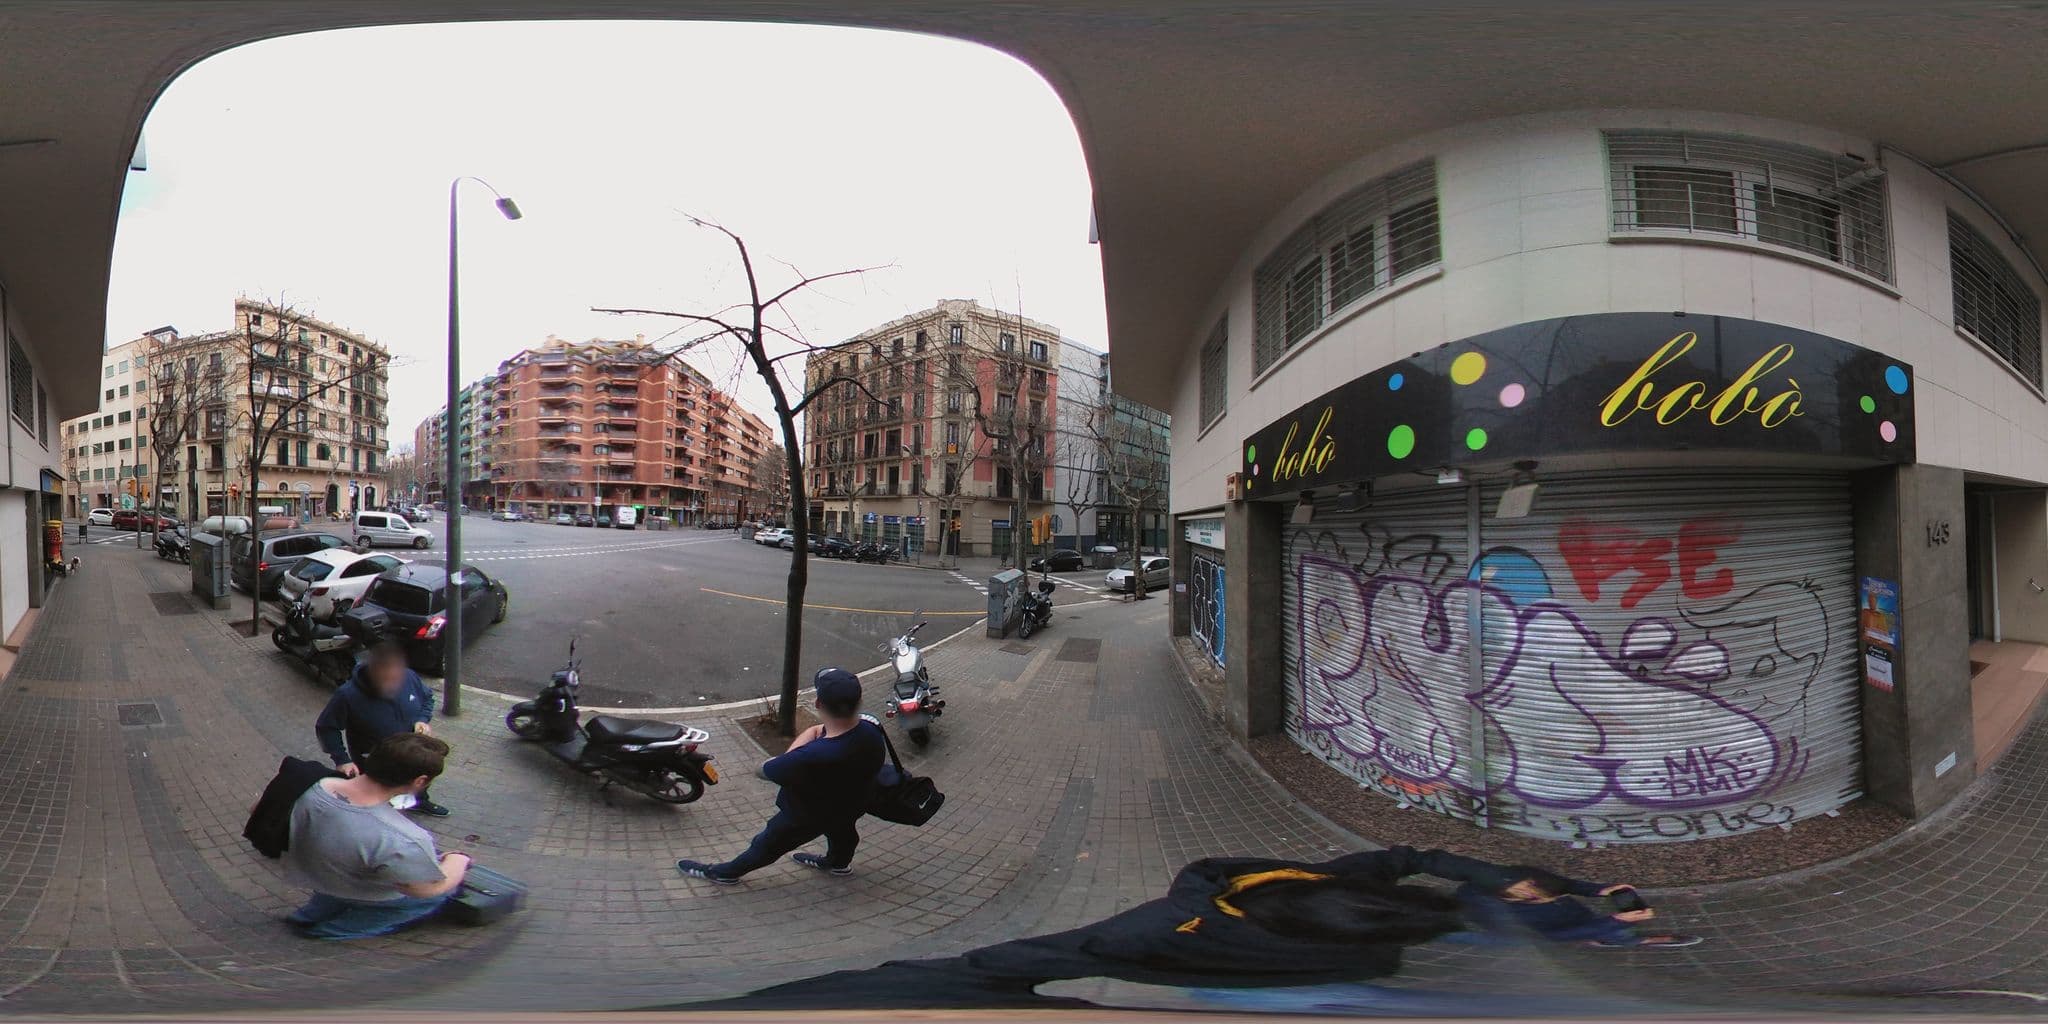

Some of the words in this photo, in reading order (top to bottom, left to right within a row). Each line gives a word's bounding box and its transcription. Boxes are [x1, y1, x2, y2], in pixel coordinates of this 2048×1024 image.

[1598, 331, 1805, 428] bobò
[1272, 406, 1337, 483] bobò
[1926, 521, 1950, 548] 143
